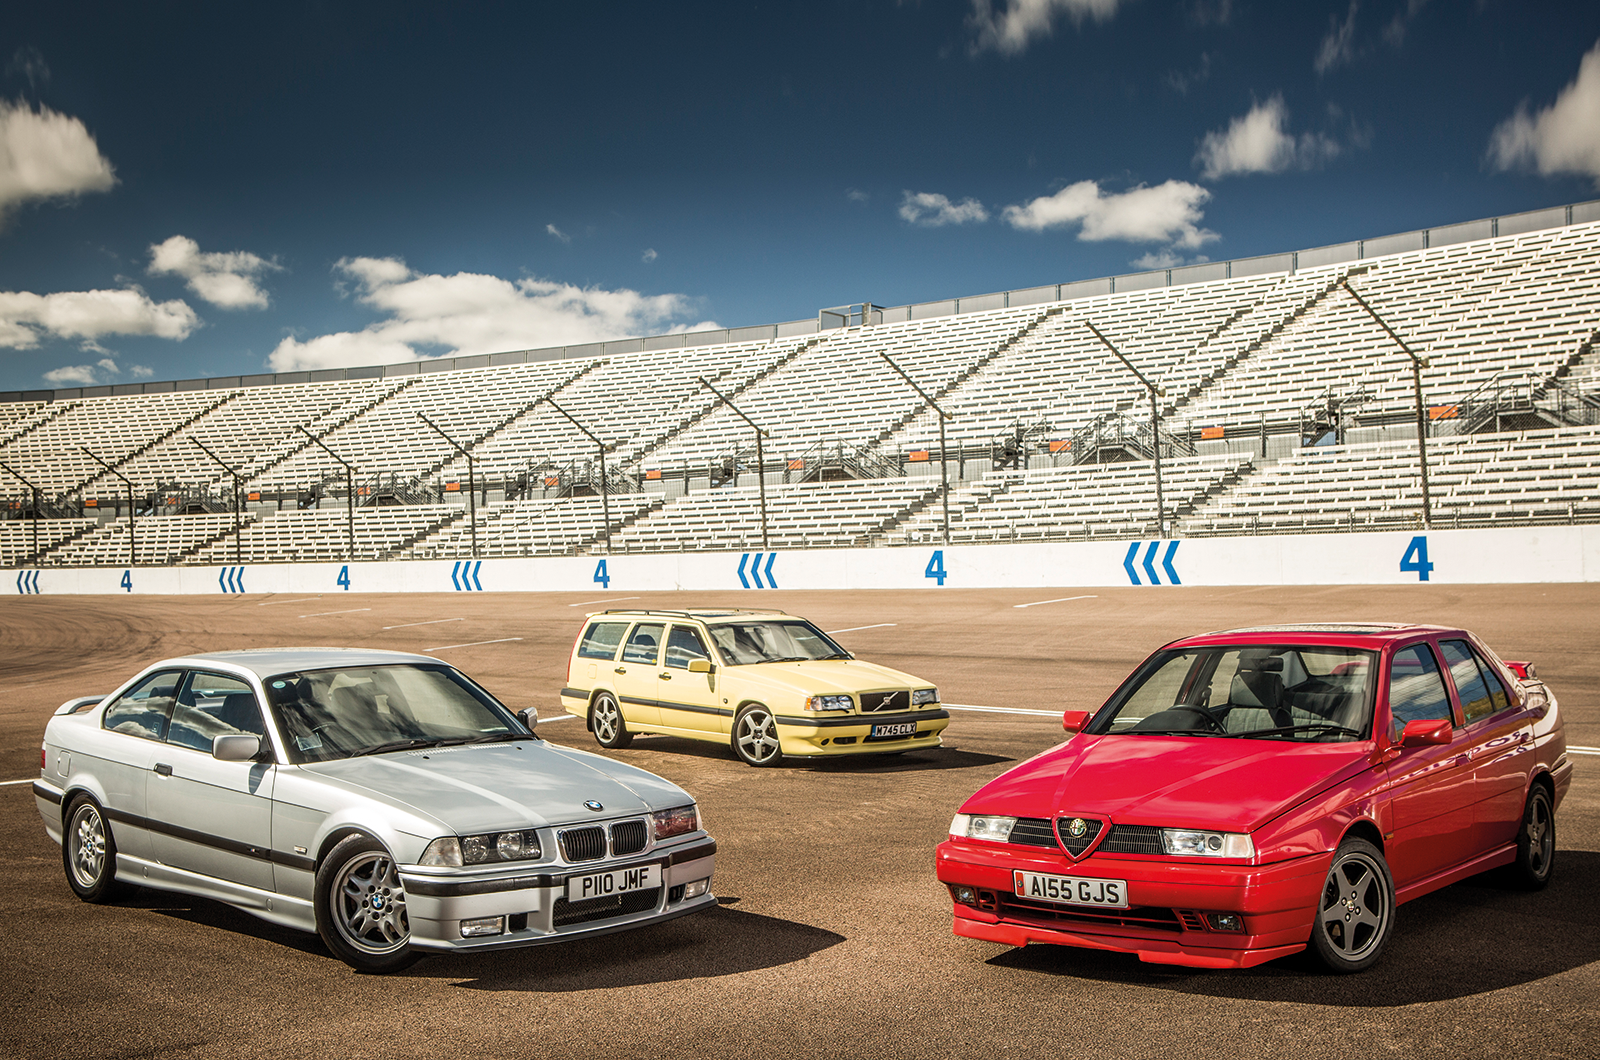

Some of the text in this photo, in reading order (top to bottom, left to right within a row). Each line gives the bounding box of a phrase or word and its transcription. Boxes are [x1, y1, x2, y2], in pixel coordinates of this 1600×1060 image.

[924, 550, 948, 586] 4
[1399, 535, 1434, 582] 4
[120, 570, 132, 592] 4
[336, 565, 351, 591] 4
[593, 559, 611, 589] 4
[876, 725, 899, 736] M745
[582, 867, 650, 898] P110 JMF
[1031, 876, 1120, 904] A155 GJS
